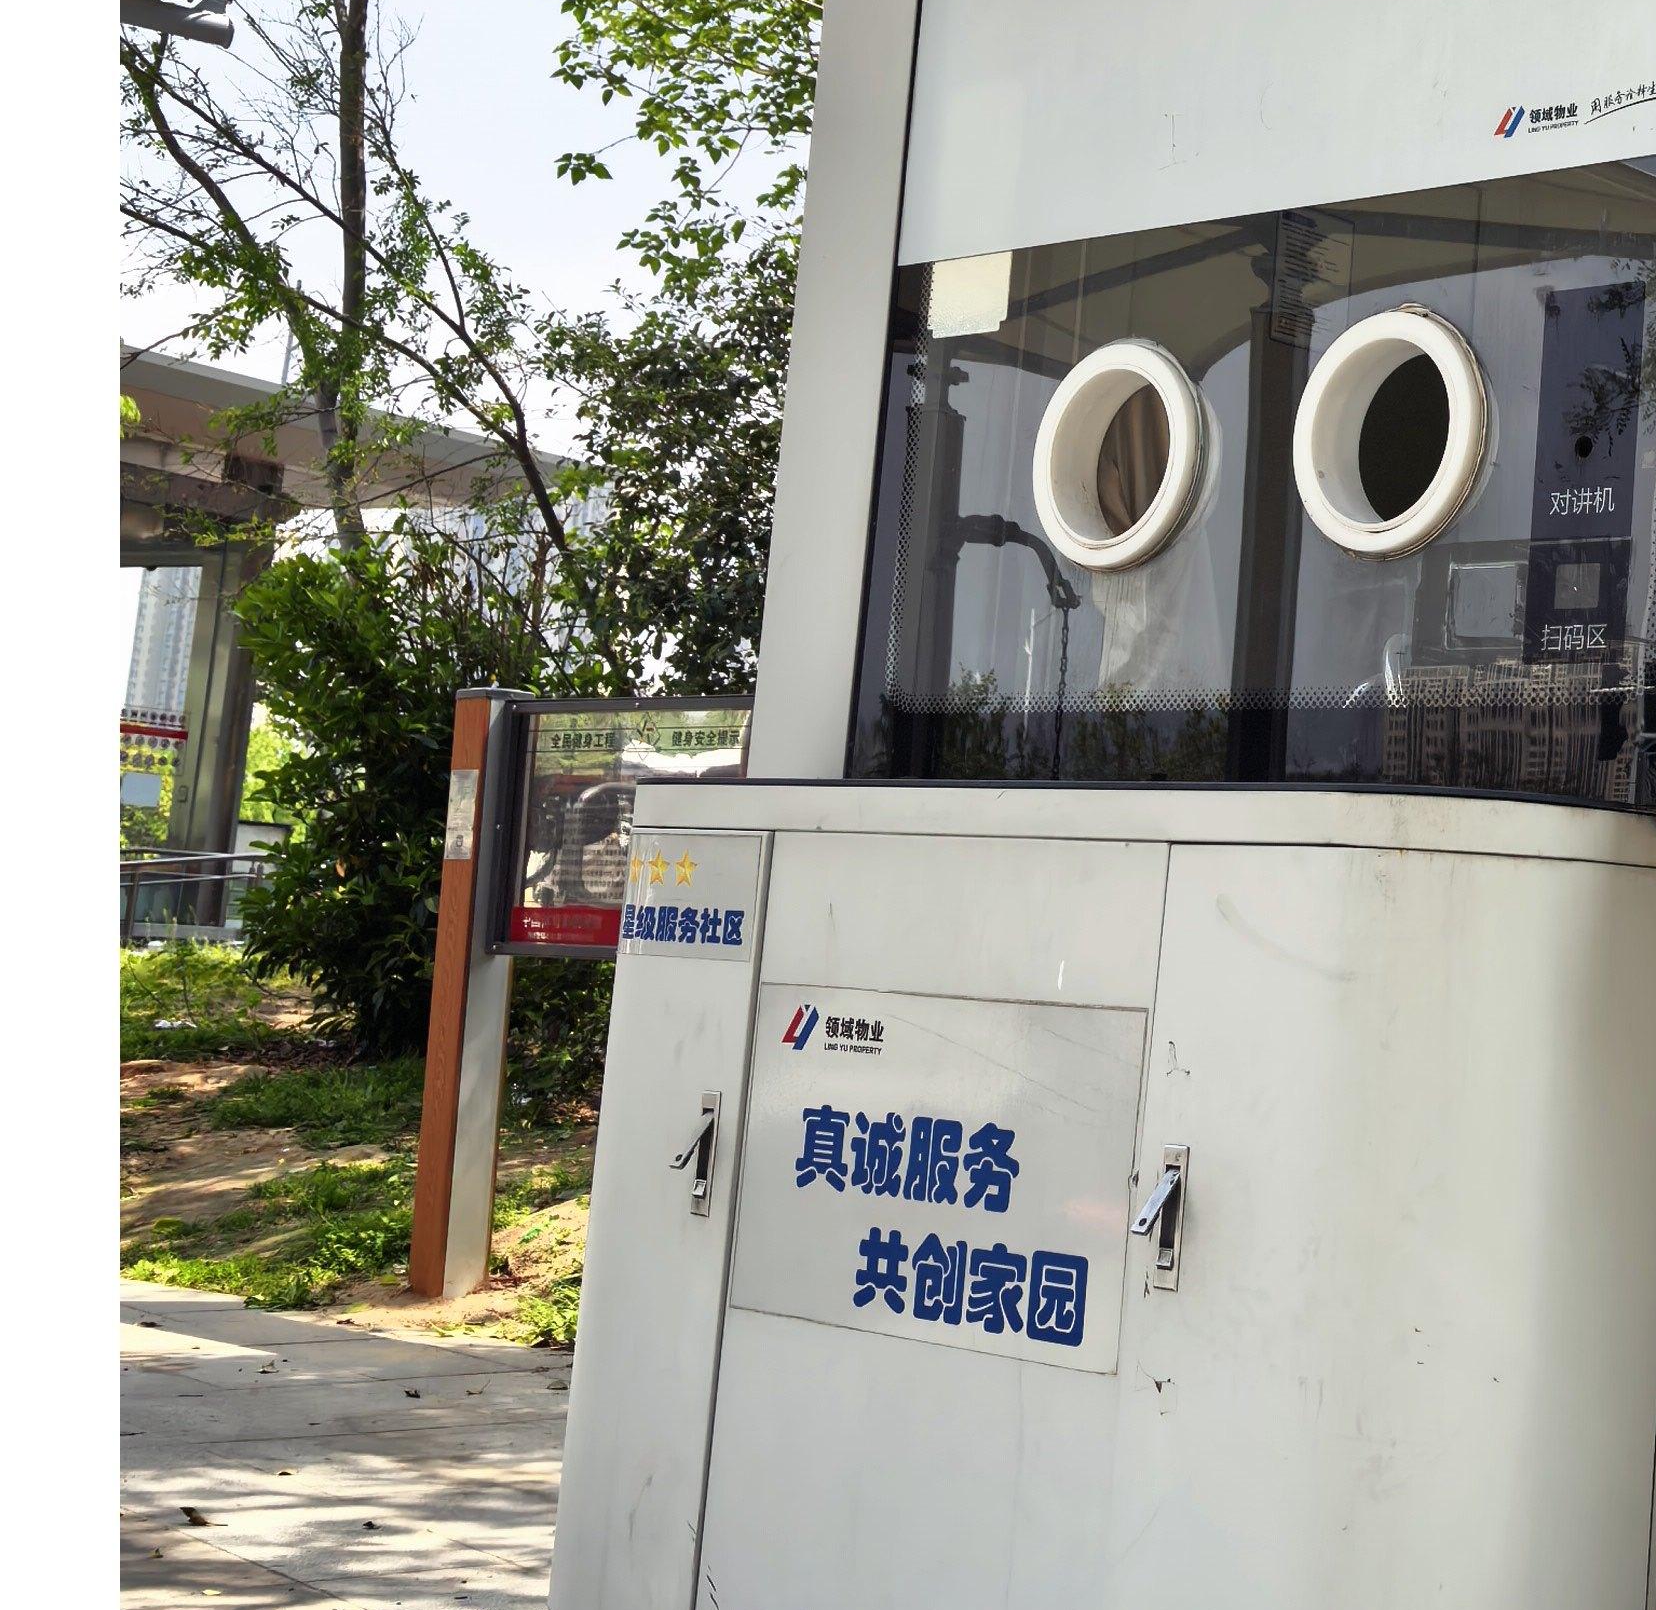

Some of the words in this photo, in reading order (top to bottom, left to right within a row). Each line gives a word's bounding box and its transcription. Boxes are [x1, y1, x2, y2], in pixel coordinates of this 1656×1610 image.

[1529, 102, 1578, 123] 领域物业
[1549, 486, 1615, 516] 对讲机
[1541, 623, 1608, 651] 扫码区
[551, 732, 615, 749] 全民健身工程
[671, 730, 740, 747] 健身安全提示
[825, 1016, 884, 1042] 领域物业
[824, 1043, 838, 1051] LING
[840, 1044, 848, 1052] YU
[849, 1045, 882, 1055] PROPERTY
[795, 1105, 1020, 1213] 真诚服务
[853, 1226, 1090, 1347] 共创家园
